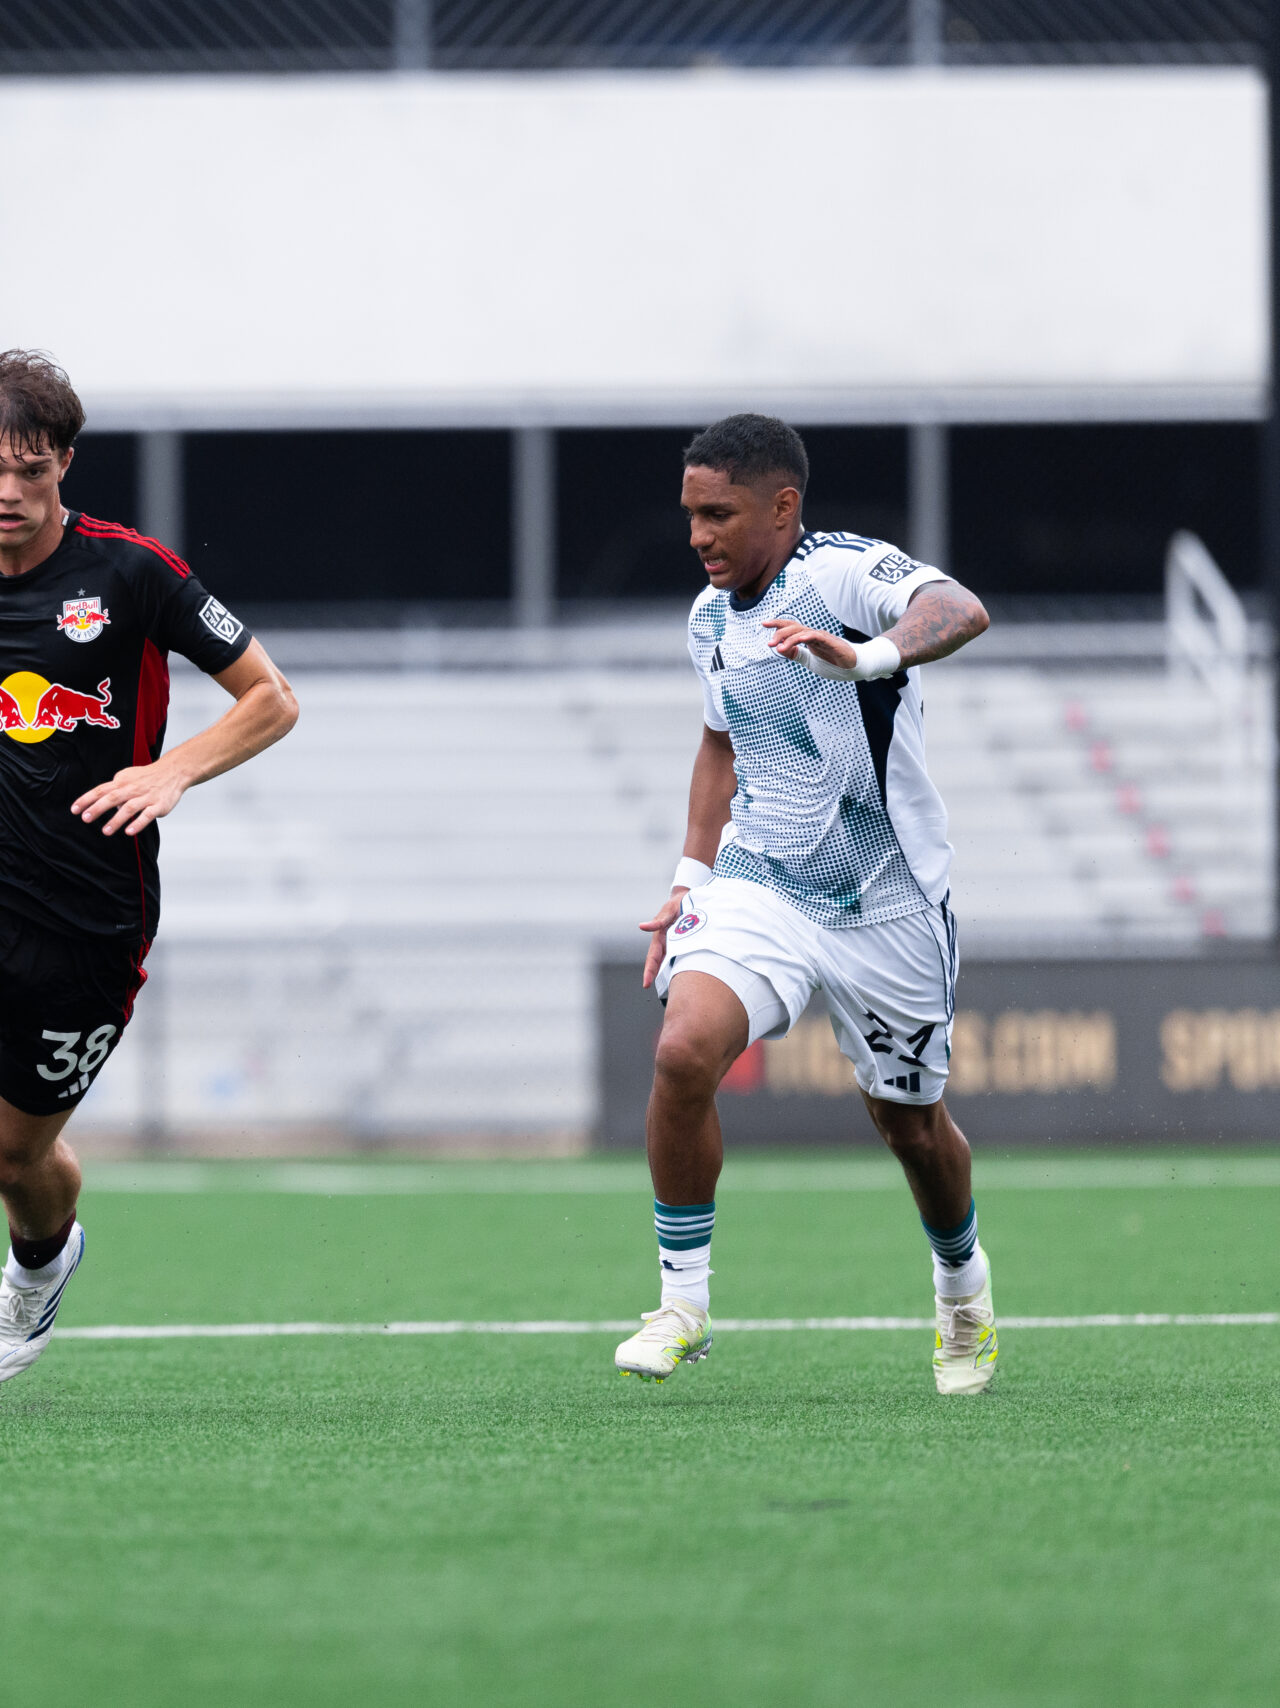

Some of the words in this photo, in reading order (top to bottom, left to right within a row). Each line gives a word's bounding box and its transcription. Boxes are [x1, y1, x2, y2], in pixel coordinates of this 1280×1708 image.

[66, 602, 81, 612] Red
[82, 600, 98, 610] Bull
[36, 1023, 117, 1081] 38
[863, 1009, 937, 1068] 21
